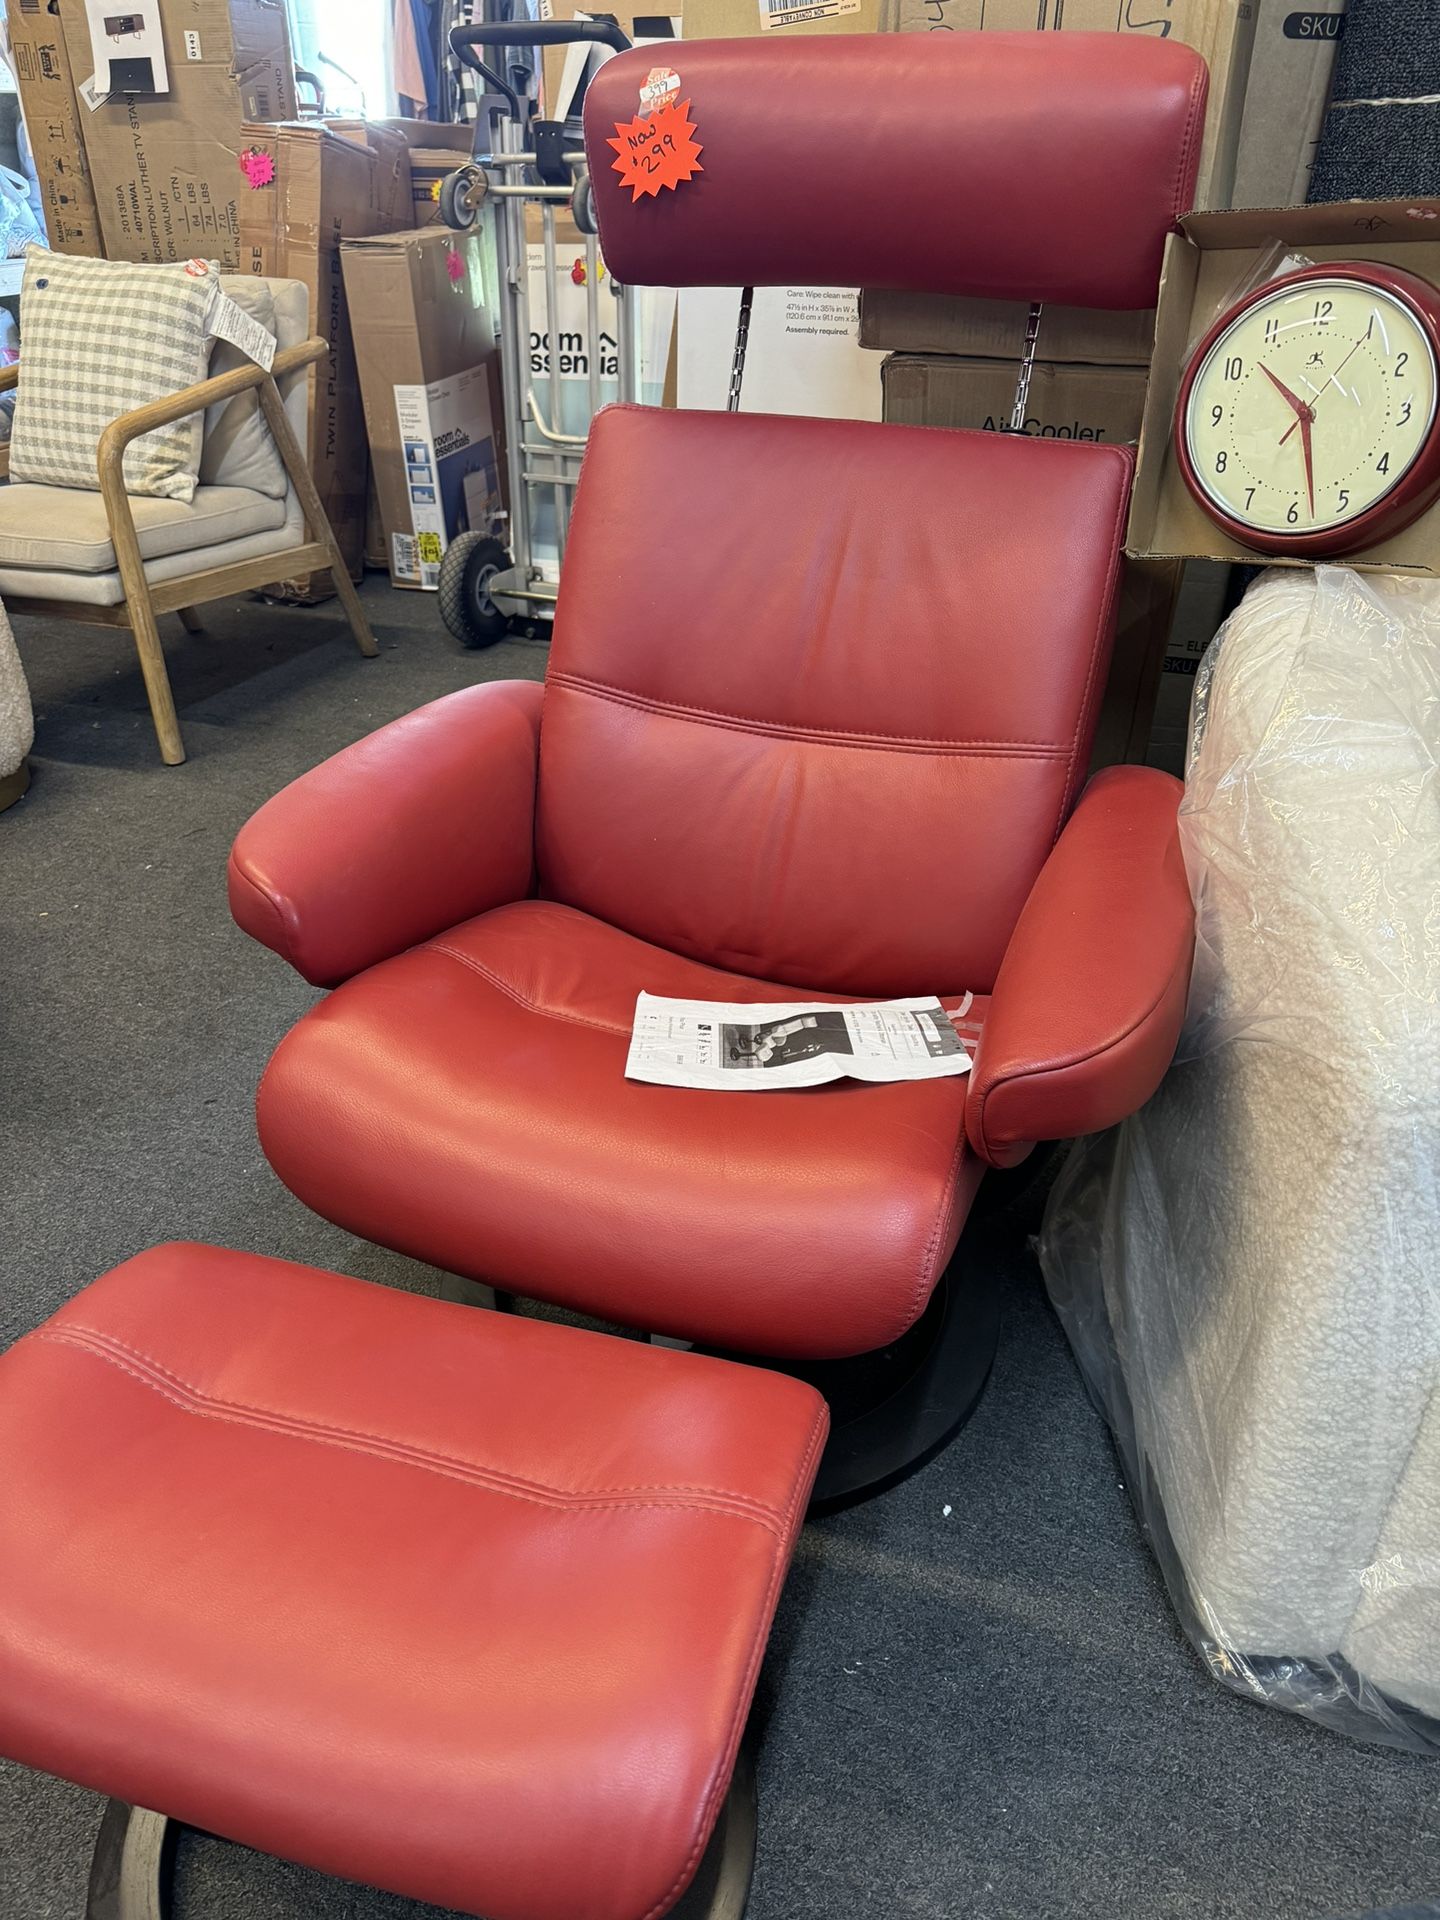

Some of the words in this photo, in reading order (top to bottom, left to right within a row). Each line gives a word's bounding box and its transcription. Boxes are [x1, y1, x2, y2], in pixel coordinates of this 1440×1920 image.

[780, 10, 812, 24] CONVEYABLE
[1299, 16, 1340, 37] SKU
[275, 68, 286, 110] STAND
[648, 80, 669, 100] 399
[133, 133, 143, 149] TV
[48, 179, 58, 206] China
[186, 182, 197, 204] LBS
[200, 182, 211, 204] LBS
[53, 208, 60, 217] in
[115, 185, 131, 233] 201398A
[128, 179, 144, 233] 40710WAL
[159, 190, 174, 236] WALNUT
[228, 200, 240, 235] CHINA
[55, 219, 65, 243] Made
[192, 214, 201, 227] 64
[205, 214, 214, 227] 74
[218, 214, 227, 229] 7.0
[166, 238, 178, 263] LOR:
[331, 216, 342, 274] BSE
[252, 246, 262, 274] SE
[786, 289, 804, 297] Care:
[805, 290, 822, 299] Wipe
[822, 291, 841, 299] clean
[1312, 301, 1333, 326] 12
[785, 326, 818, 335] Assembly
[818, 328, 849, 336] required.
[1264, 319, 1279, 343] 11
[1366, 314, 1374, 340] 1
[327, 284, 340, 397] PLATFORM
[530, 332, 583, 352] oom
[1224, 357, 1242, 381] 10
[1394, 352, 1409, 377] 2
[1211, 405, 1223, 427] 9
[1396, 402, 1411, 427] 3
[326, 406, 337, 459] TWIN
[434, 431, 454, 447] room
[1024, 418, 1105, 443] Cooler
[435, 434, 471, 458] essentials
[1215, 451, 1228, 474] 8
[1376, 452, 1389, 475] 4
[1245, 488, 1256, 511] 7
[1336, 490, 1350, 513] 5
[1287, 502, 1299, 524] 6
